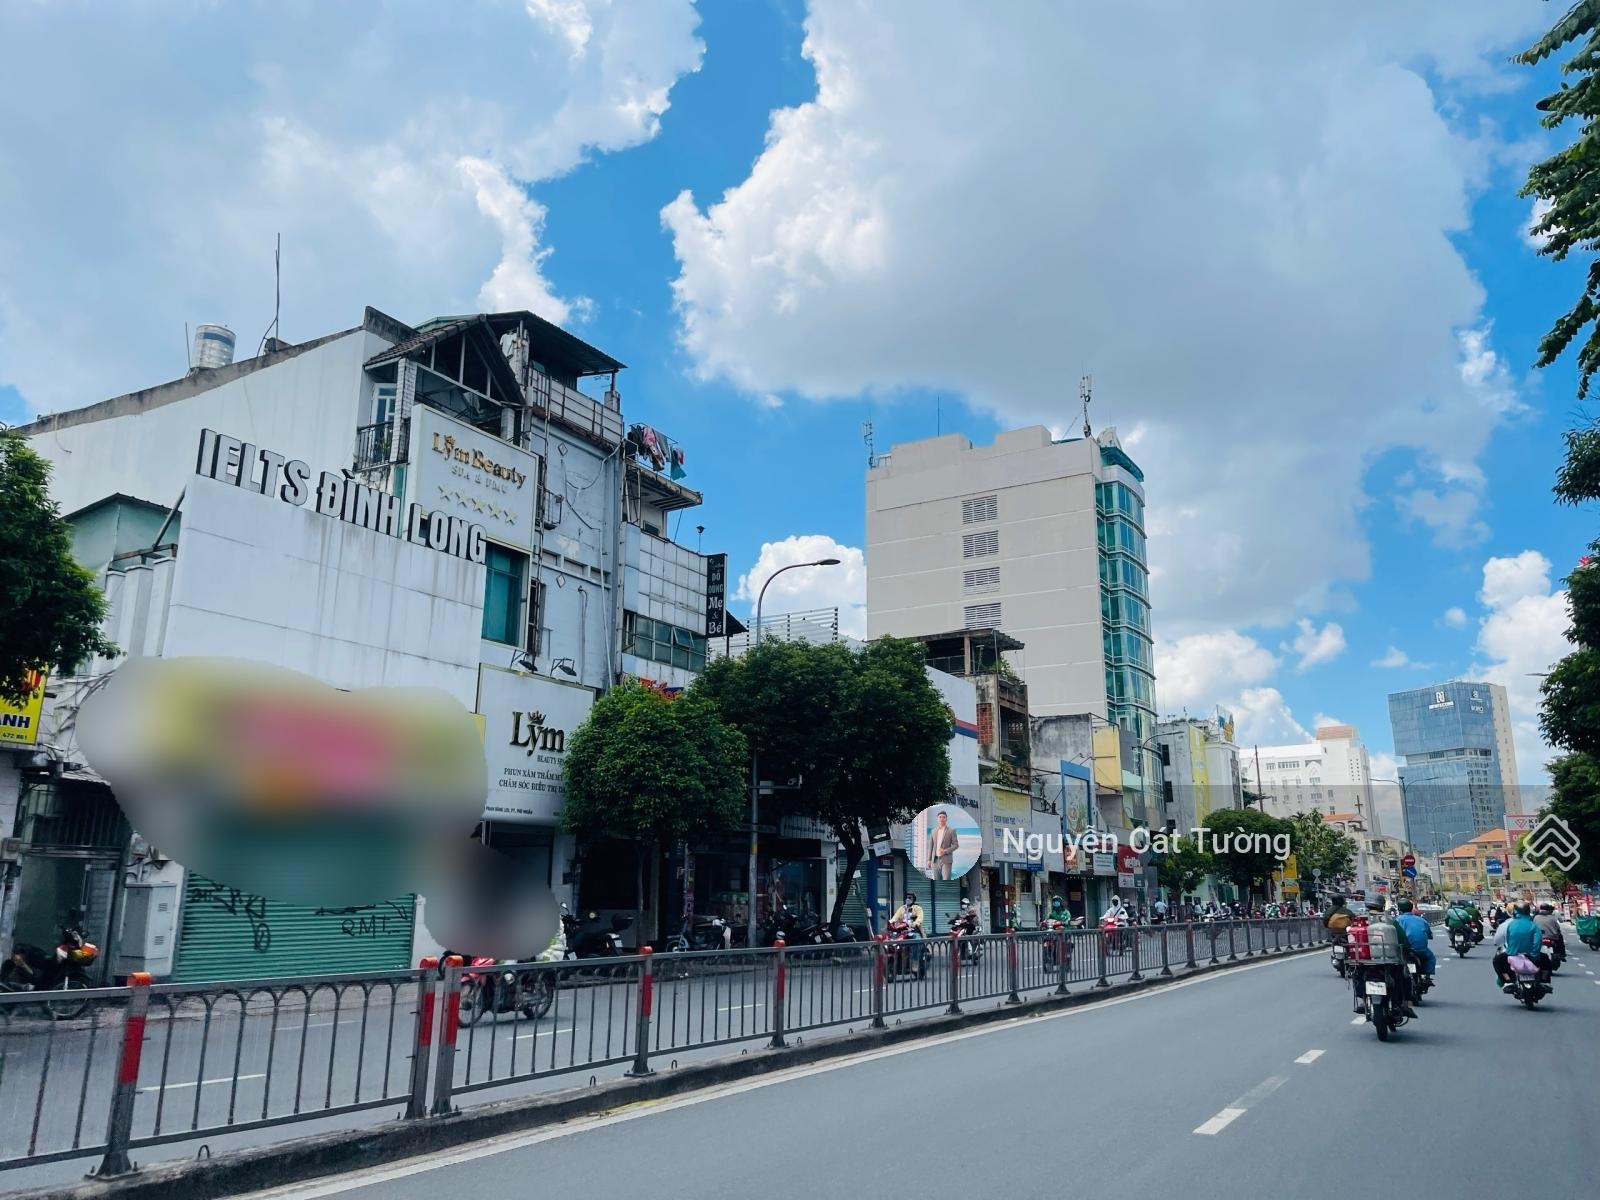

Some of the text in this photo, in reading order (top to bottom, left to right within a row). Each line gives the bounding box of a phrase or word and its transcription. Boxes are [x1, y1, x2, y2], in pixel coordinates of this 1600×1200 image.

[472, 448, 527, 489] Beauty
[196, 428, 487, 564] IELTS ĐÌNH LONG
[708, 596, 723, 611] Mẹ
[708, 621, 722, 634] Bé
[0, 713, 31, 728] NH
